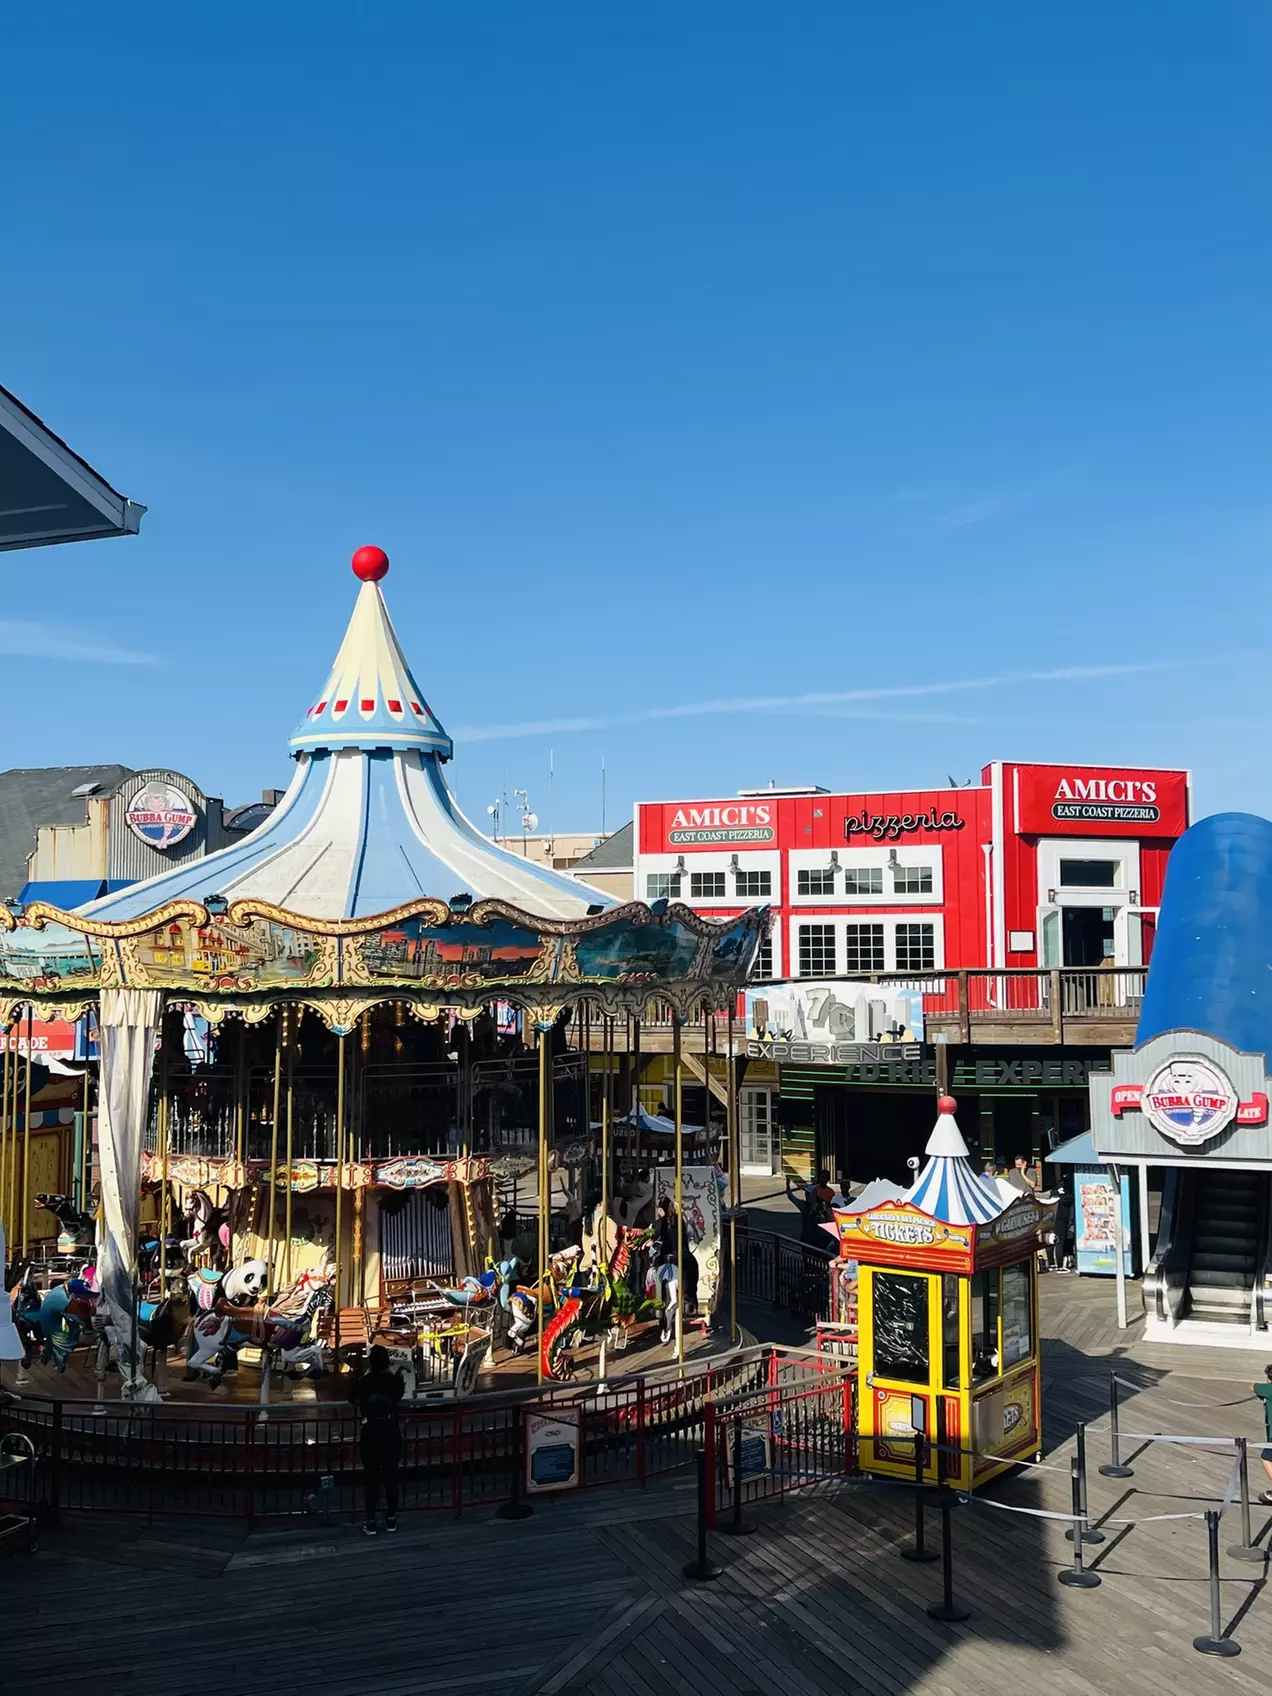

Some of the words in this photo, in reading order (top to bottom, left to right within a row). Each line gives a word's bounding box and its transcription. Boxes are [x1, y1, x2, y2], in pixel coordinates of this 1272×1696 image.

[1054, 778, 1157, 802] AMICI'S
[129, 813, 162, 823] BUBBA
[164, 813, 193, 824] GUMP
[671, 805, 771, 827] AMICI'S
[1057, 805, 1081, 816] EAST
[1082, 806, 1113, 817] COAST
[1114, 808, 1155, 819] PIZZERIA
[844, 807, 965, 842] pizzeria
[674, 832, 697, 842] EAST
[697, 830, 728, 841] COAST
[728, 829, 769, 840] PIZZERIA
[747, 1042, 921, 1062] EXPERIENCE
[1115, 1090, 1141, 1103] OPEN
[1152, 1096, 1191, 1109] BUBBA
[1193, 1094, 1226, 1109] GUMP
[1238, 1107, 1262, 1119] LATE
[871, 1222, 934, 1244] TICKETS
